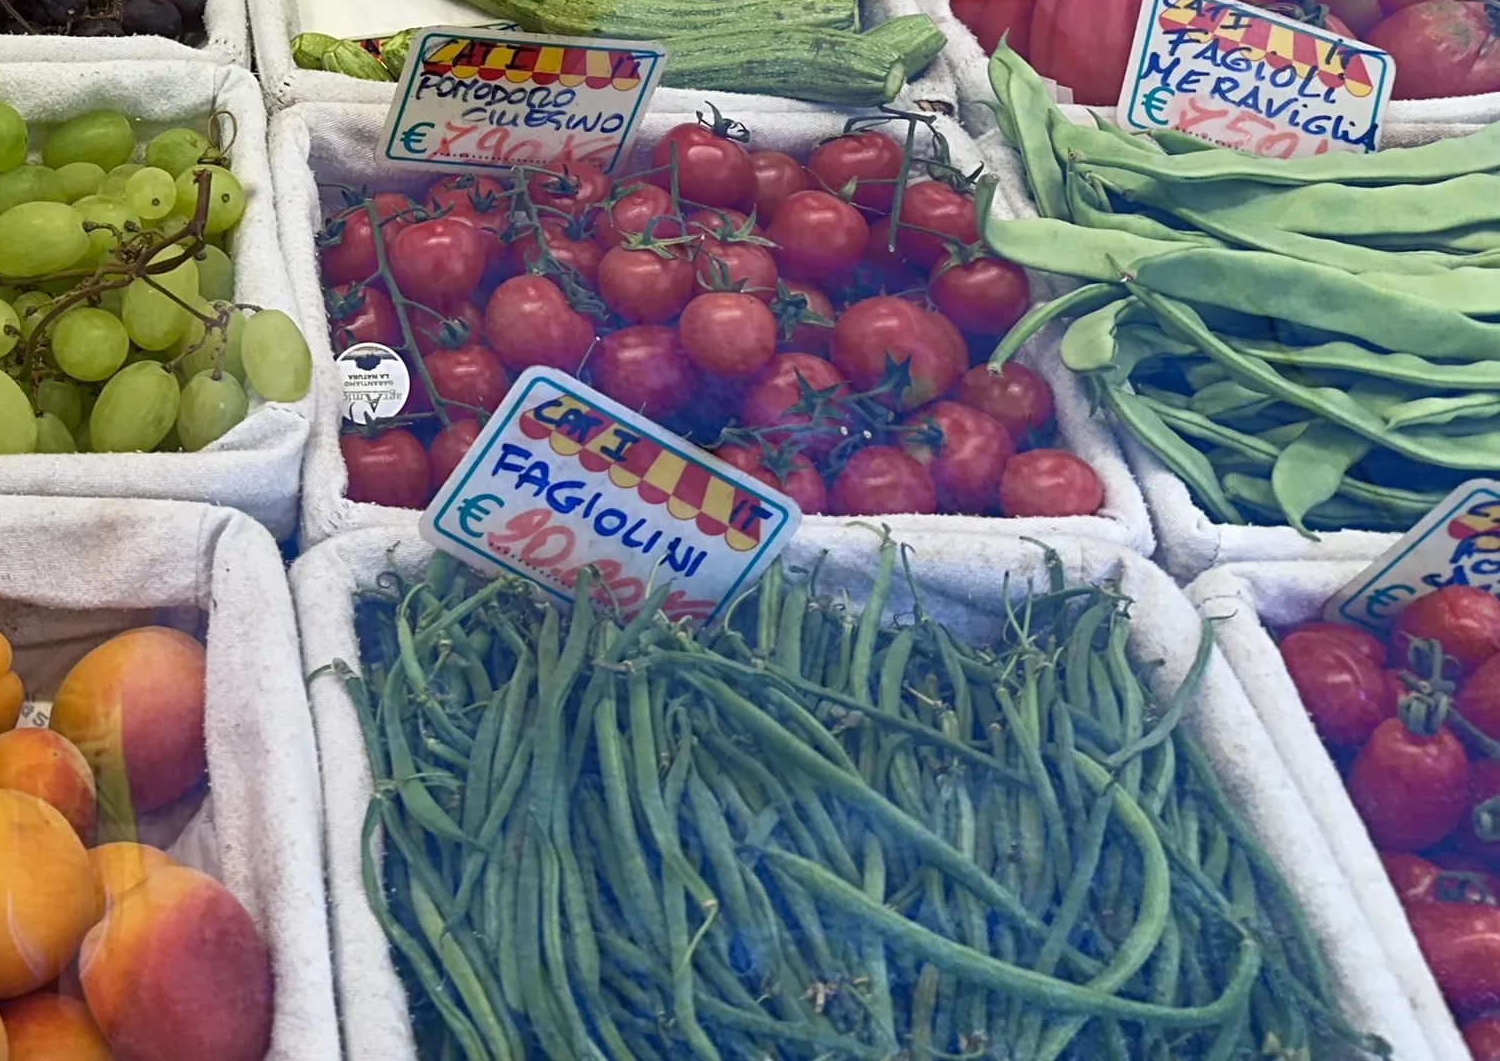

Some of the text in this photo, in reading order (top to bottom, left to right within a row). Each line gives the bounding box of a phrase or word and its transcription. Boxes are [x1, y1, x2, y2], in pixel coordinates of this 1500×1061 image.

[414, 71, 577, 109] POMODORO
[1140, 85, 1176, 126] €
[399, 121, 436, 154] €
[456, 492, 506, 539] €
[491, 442, 709, 579] FAGIOLINI
[1366, 584, 1417, 619] €
